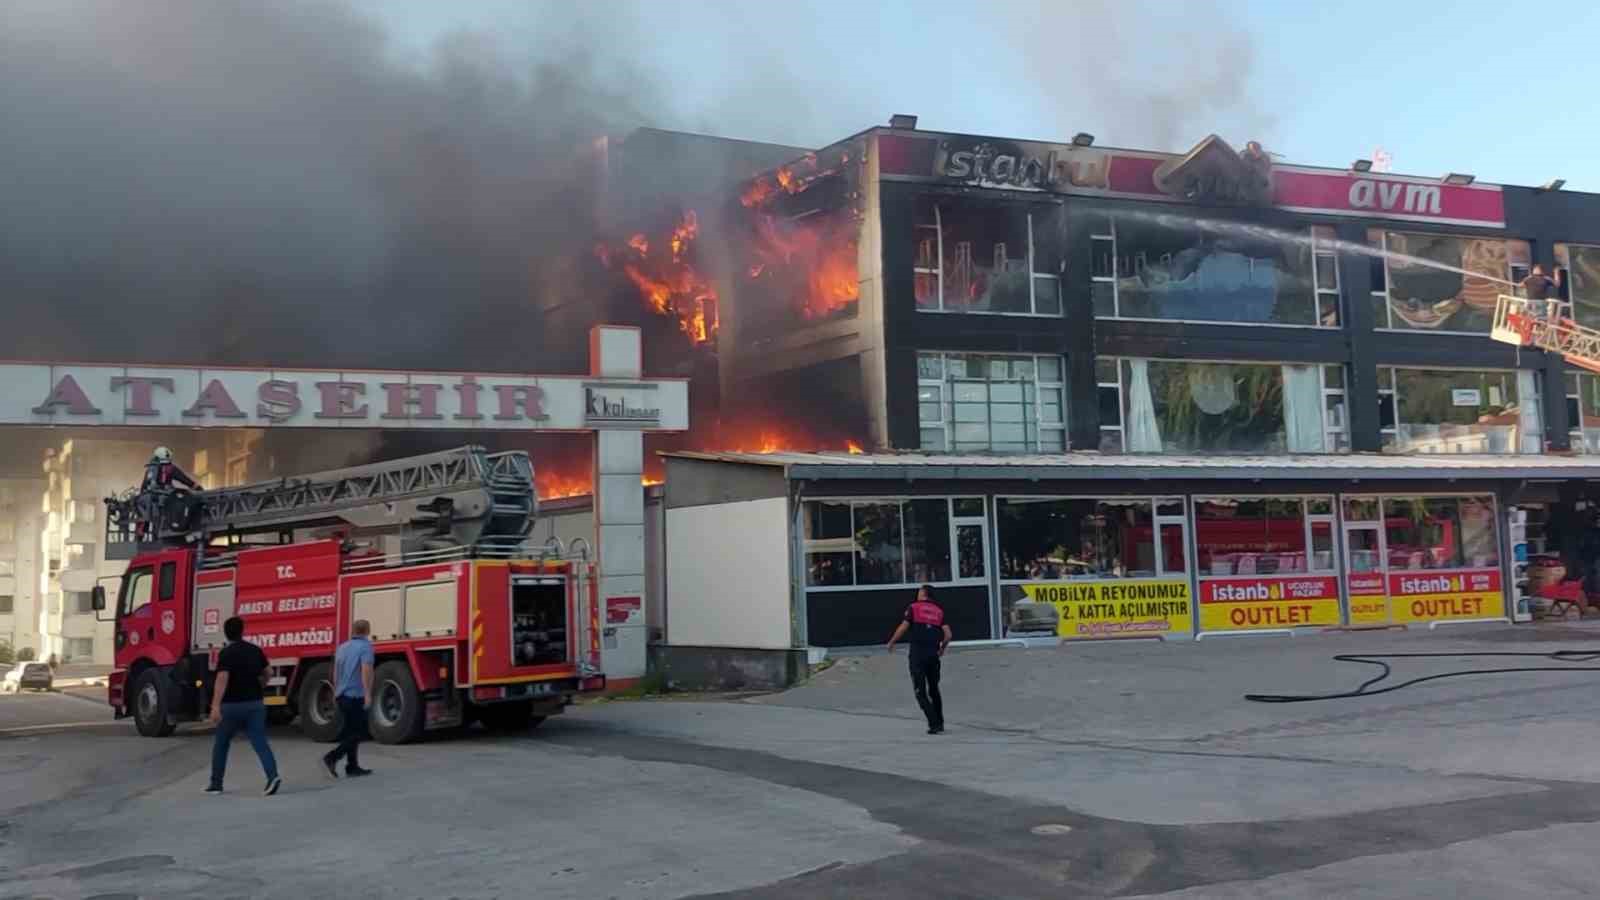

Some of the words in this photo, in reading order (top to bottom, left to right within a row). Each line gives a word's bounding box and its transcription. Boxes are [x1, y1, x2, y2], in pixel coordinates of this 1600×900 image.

[1349, 179, 1442, 214] avm
[32, 373, 550, 424] ATAŞEHİR
[276, 565, 297, 578] T.C.
[1101, 583, 1187, 600] REYONUMUZ
[1063, 606, 1074, 620] 2.
[1079, 603, 1116, 619] KATTA
[1120, 601, 1188, 621] AÇILMIŞTIR
[1230, 605, 1313, 625] OUTLET
[1411, 597, 1484, 616] OUTLET
[277, 627, 334, 647] ARAZÖZÜ
